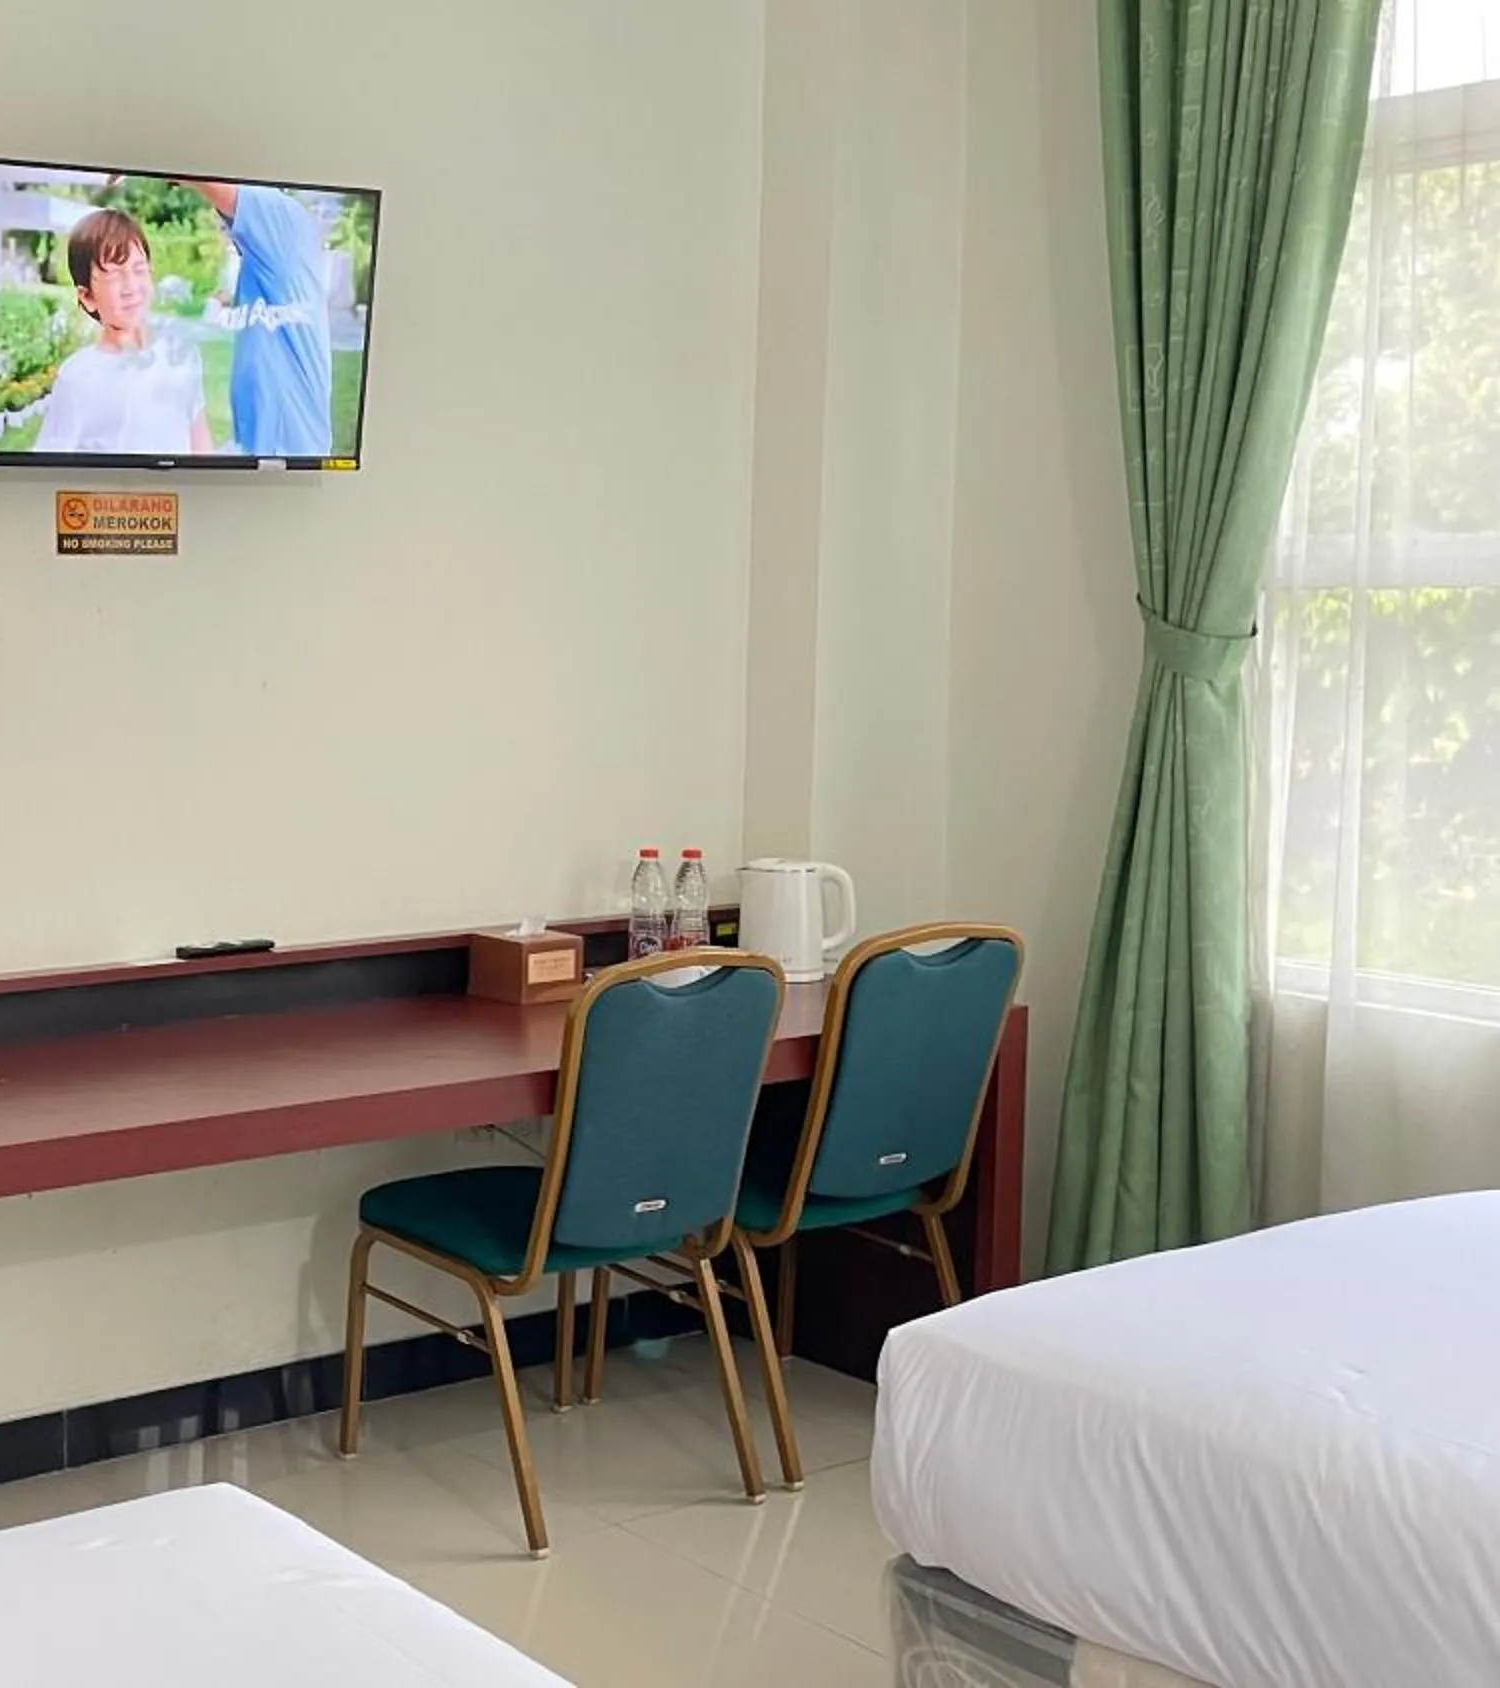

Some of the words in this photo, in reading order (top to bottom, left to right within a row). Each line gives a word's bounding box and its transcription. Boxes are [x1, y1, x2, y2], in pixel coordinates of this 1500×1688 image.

[92, 498, 173, 513] DILARANG
[92, 515, 172, 530] MEROKOK
[63, 538, 78, 549] NO
[81, 538, 131, 549] SMOKING
[134, 538, 173, 549] PLEASE
